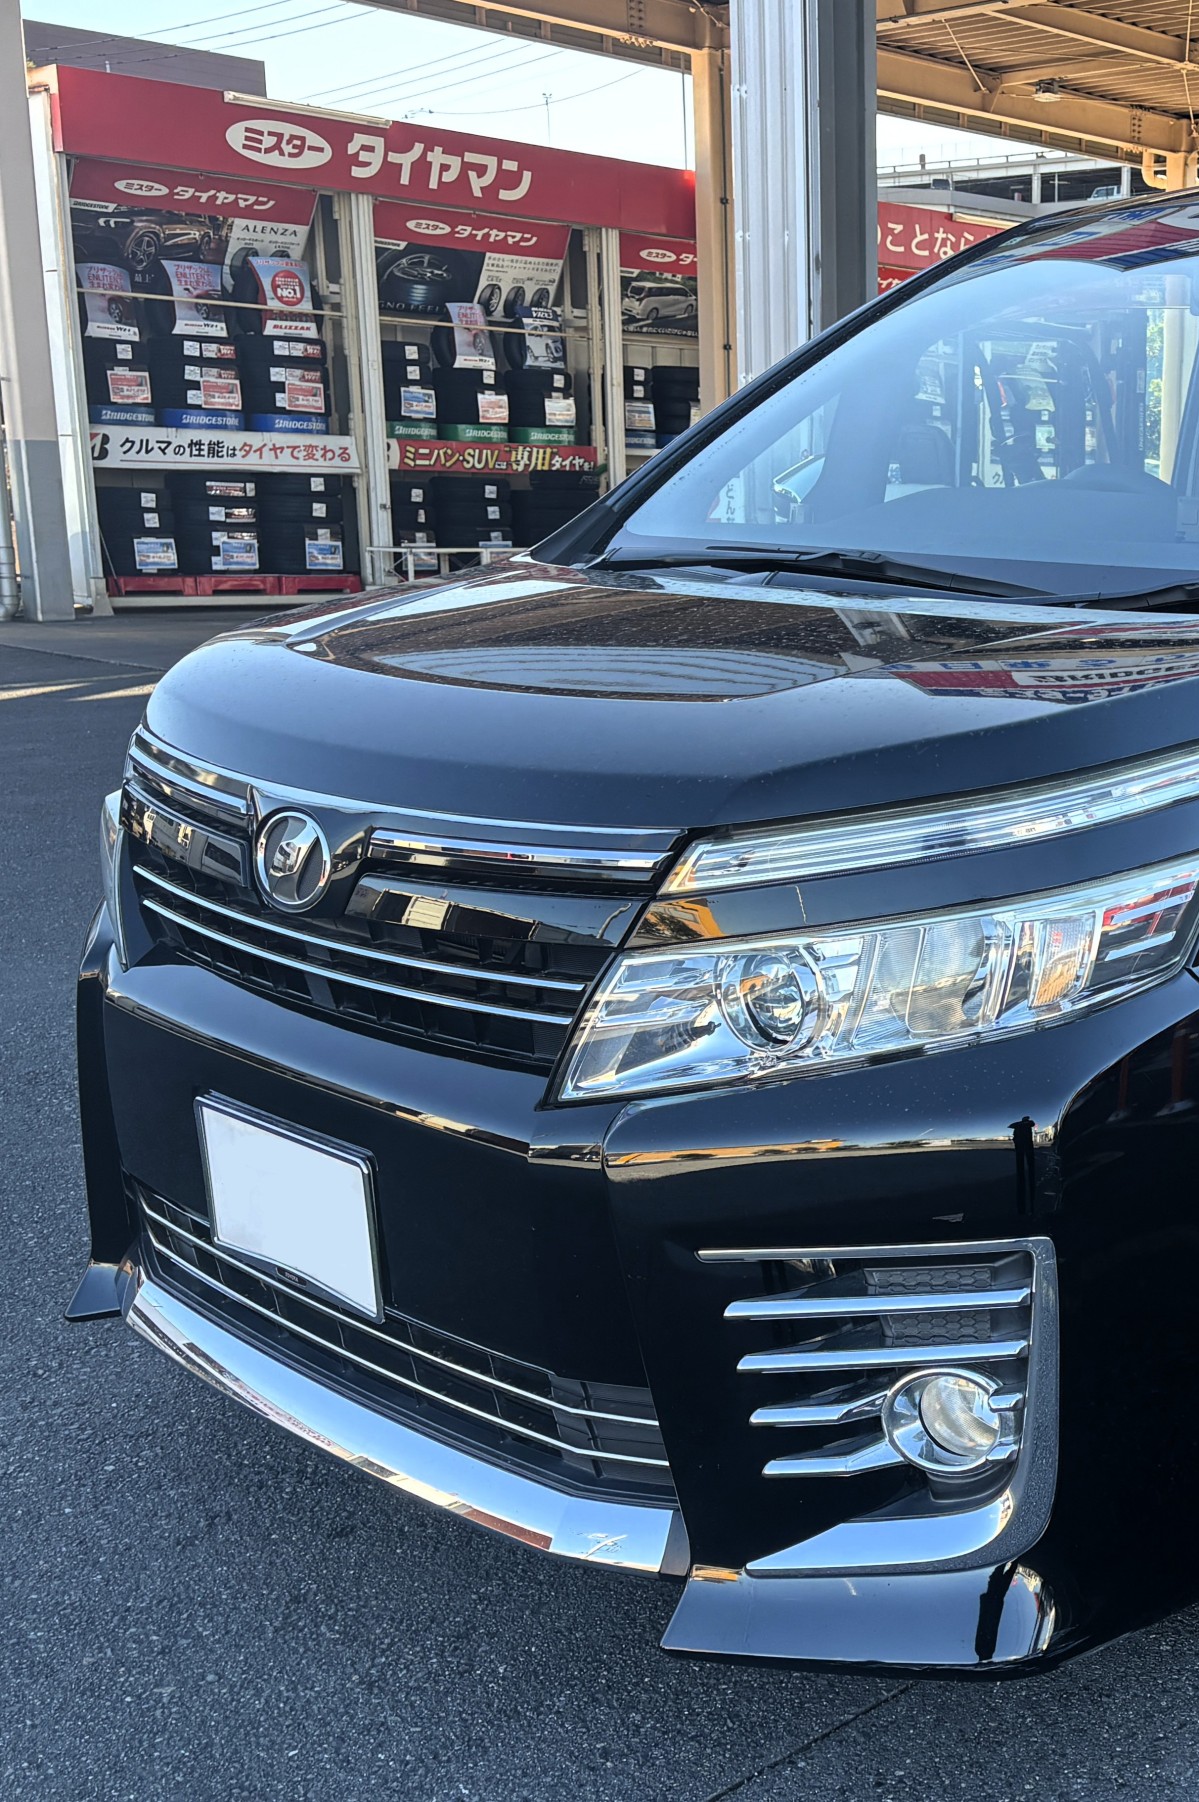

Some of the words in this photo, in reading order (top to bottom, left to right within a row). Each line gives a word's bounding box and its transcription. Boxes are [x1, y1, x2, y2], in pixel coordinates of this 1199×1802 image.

[242, 126, 325, 159] ミスター
[347, 133, 532, 201] タイヤマン
[123, 182, 163, 194] ミスター
[173, 186, 276, 211] タイヤマン
[241, 224, 298, 238] ALENZA
[413, 221, 446, 232] ミスター
[454, 225, 538, 247] タイヤマン
[645, 251, 673, 260] ミスター
[678, 253, 697, 265] タ
[182, 414, 239, 426] BRIDGESTONE
[119, 437, 352, 463] クルマの性能はタイヤで変わる
